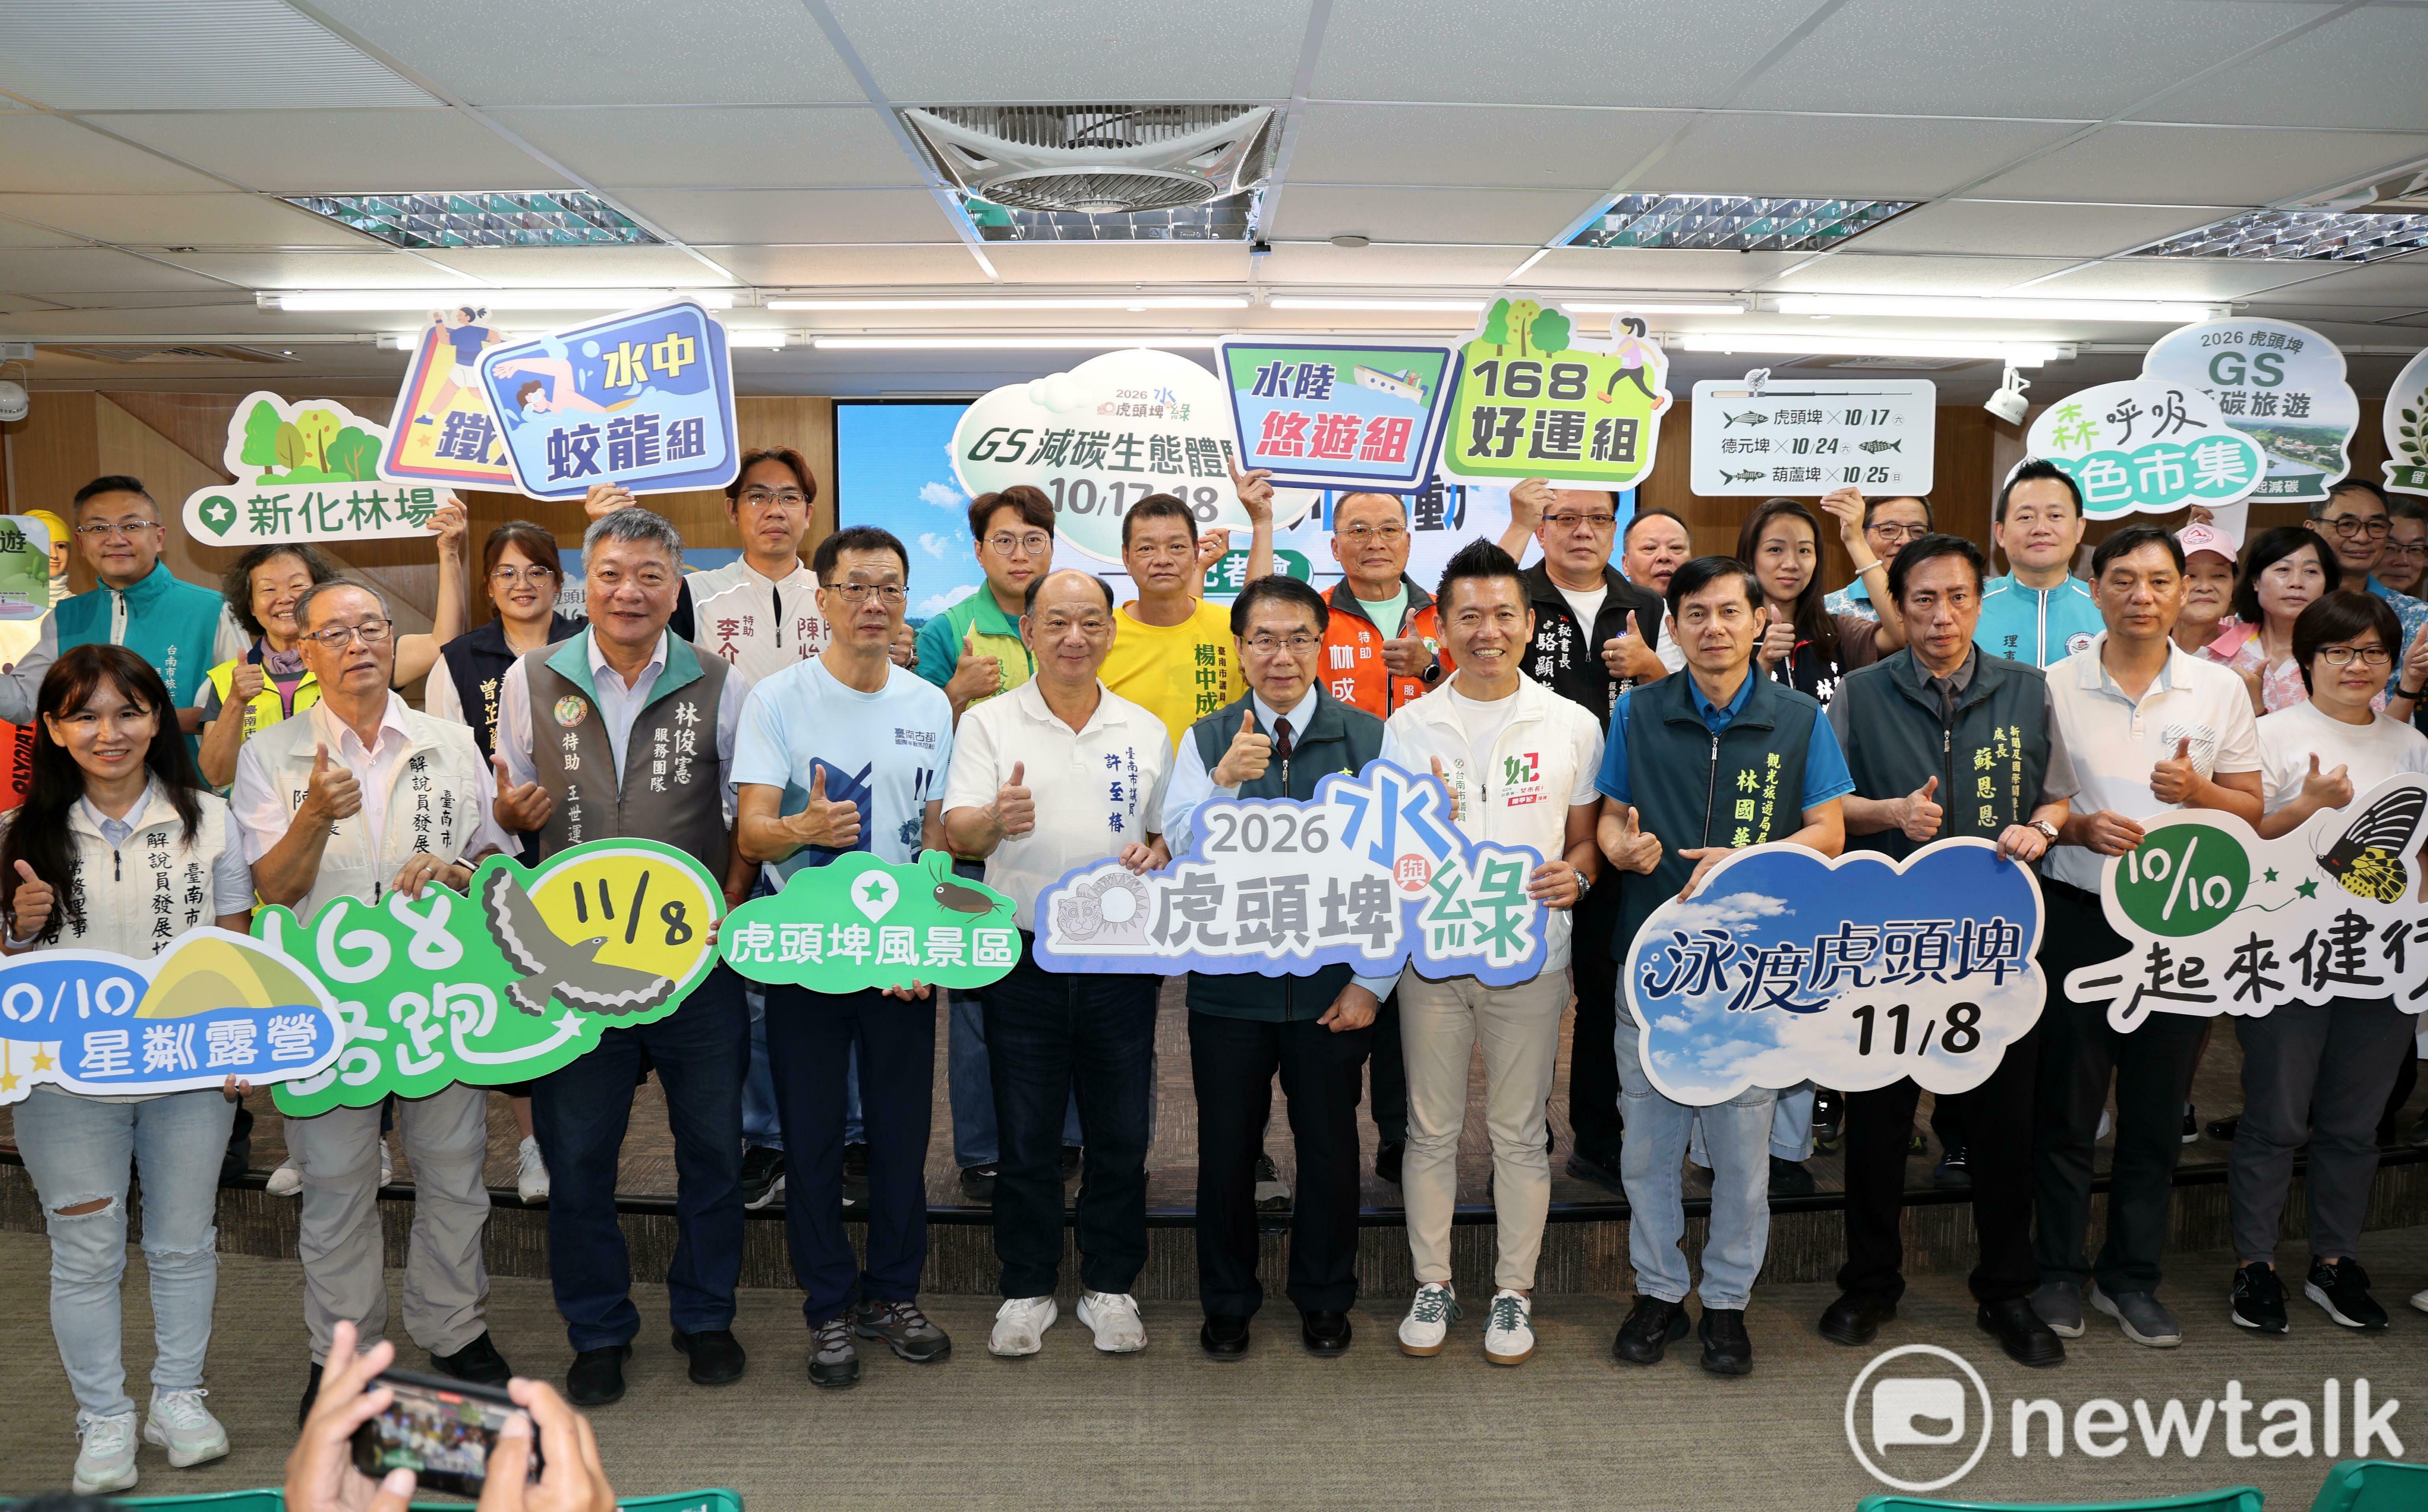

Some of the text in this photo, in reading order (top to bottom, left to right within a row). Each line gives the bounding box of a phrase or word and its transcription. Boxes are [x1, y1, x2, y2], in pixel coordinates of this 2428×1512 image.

[602, 332, 695, 390] 水中
[2201, 330, 2304, 355] 2026 虎頭埤
[2209, 351, 2285, 387] GS
[1116, 390, 1147, 399] 2026
[1250, 359, 1338, 401] 水陸
[1471, 359, 1589, 401] 168
[1115, 402, 1164, 418] 虎頭埤
[1254, 410, 1415, 464] 悠遊組
[1467, 404, 1641, 463] 好運組
[1774, 409, 1823, 425] 虎頭埤
[1844, 409, 1890, 426] 10/17
[2052, 390, 2207, 451] 森呼吸
[435, 411, 508, 466] 鐵
[546, 412, 707, 483] 蛟龍組
[1721, 438, 1770, 454] 德元埤
[1791, 438, 1839, 455] 10/24
[1773, 467, 1821, 482] 葫蘆埤
[1843, 467, 1889, 483] 10/25
[2055, 441, 2248, 503] 色市集
[248, 488, 436, 536] 新化林場
[743, 615, 754, 637] 特助
[1358, 631, 1372, 659] 特助
[1558, 623, 1572, 670] 秘書長
[1194, 643, 1218, 715] 楊中成
[1218, 646, 1227, 702] 臺南市議員
[1329, 644, 1356, 703] 林成
[562, 733, 580, 770] 特助
[651, 728, 670, 792] 服務團隊
[673, 702, 702, 784] 林俊憲
[895, 728, 935, 742] 臺南古都
[1993, 727, 2009, 758] 處長
[409, 756, 433, 854] 解說員發展
[1104, 753, 1125, 833] 許至椿
[1126, 747, 1138, 817] 臺南市議員
[1455, 771, 1466, 822] 台南市議員
[1731, 769, 1761, 848] 林國華
[1973, 747, 1998, 827] 蘇恩恩
[440, 789, 456, 849] 臺南市
[568, 785, 583, 844] 王世運
[1212, 813, 1328, 853] 2026
[184, 863, 204, 927] 臺南市
[2127, 836, 2232, 921] 10/10
[573, 870, 693, 945] 11/8
[1151, 871, 1393, 948] 虎頭埤
[728, 921, 1013, 967] 虎頭埤風景區
[1642, 916, 2021, 1014] 泳渡虎頭埤
[1852, 1002, 1981, 1056] 11/8
